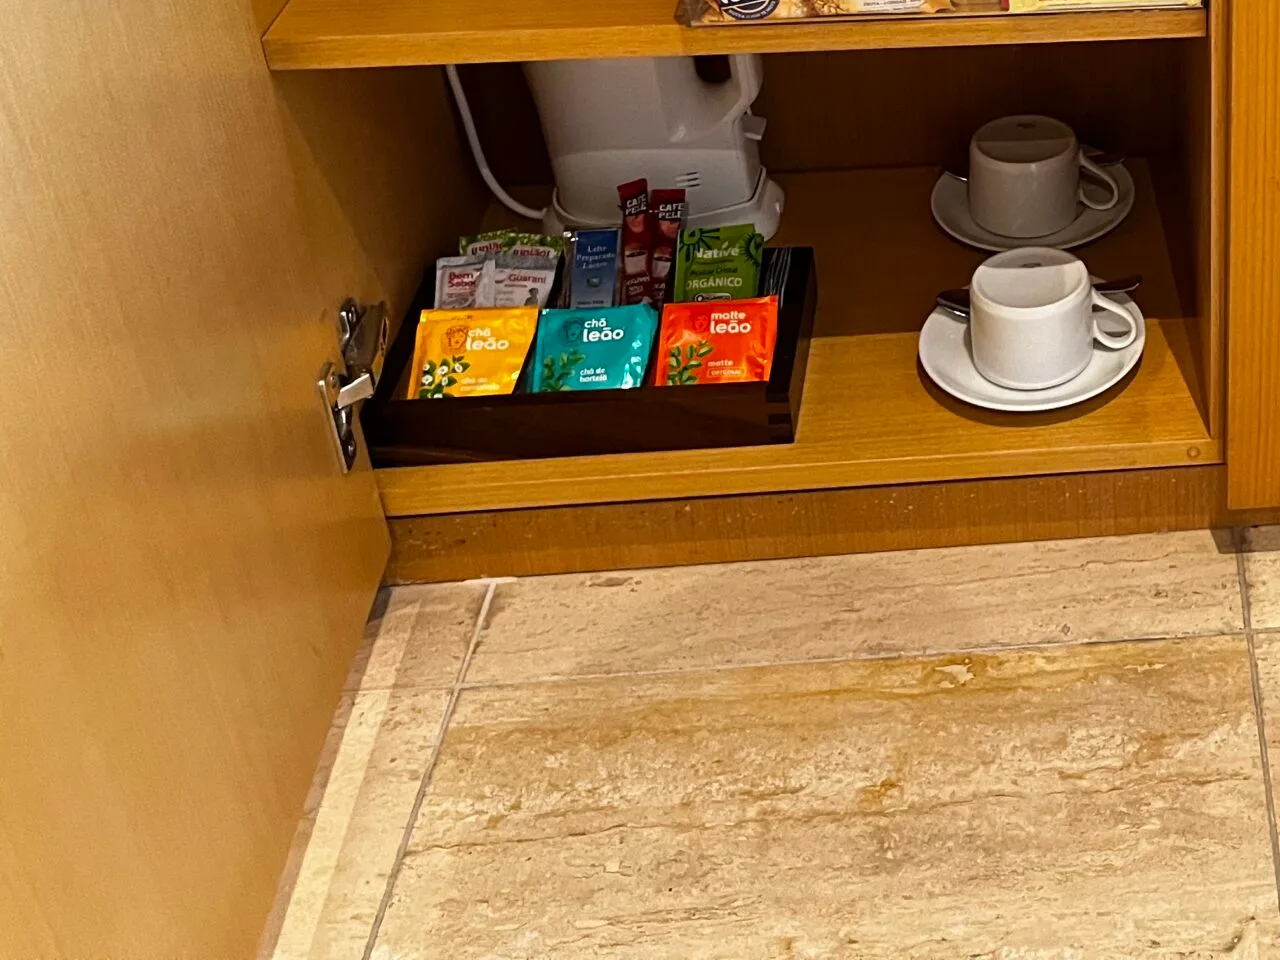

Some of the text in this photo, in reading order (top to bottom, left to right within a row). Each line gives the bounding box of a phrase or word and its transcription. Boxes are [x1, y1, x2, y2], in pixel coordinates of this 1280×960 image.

[508, 273, 547, 284] Guarani
[711, 311, 746, 321] matte
[710, 319, 751, 334] leão
[582, 326, 624, 342] leão
[465, 337, 509, 351] leão
[708, 359, 733, 367] matte
[595, 367, 606, 375] de
